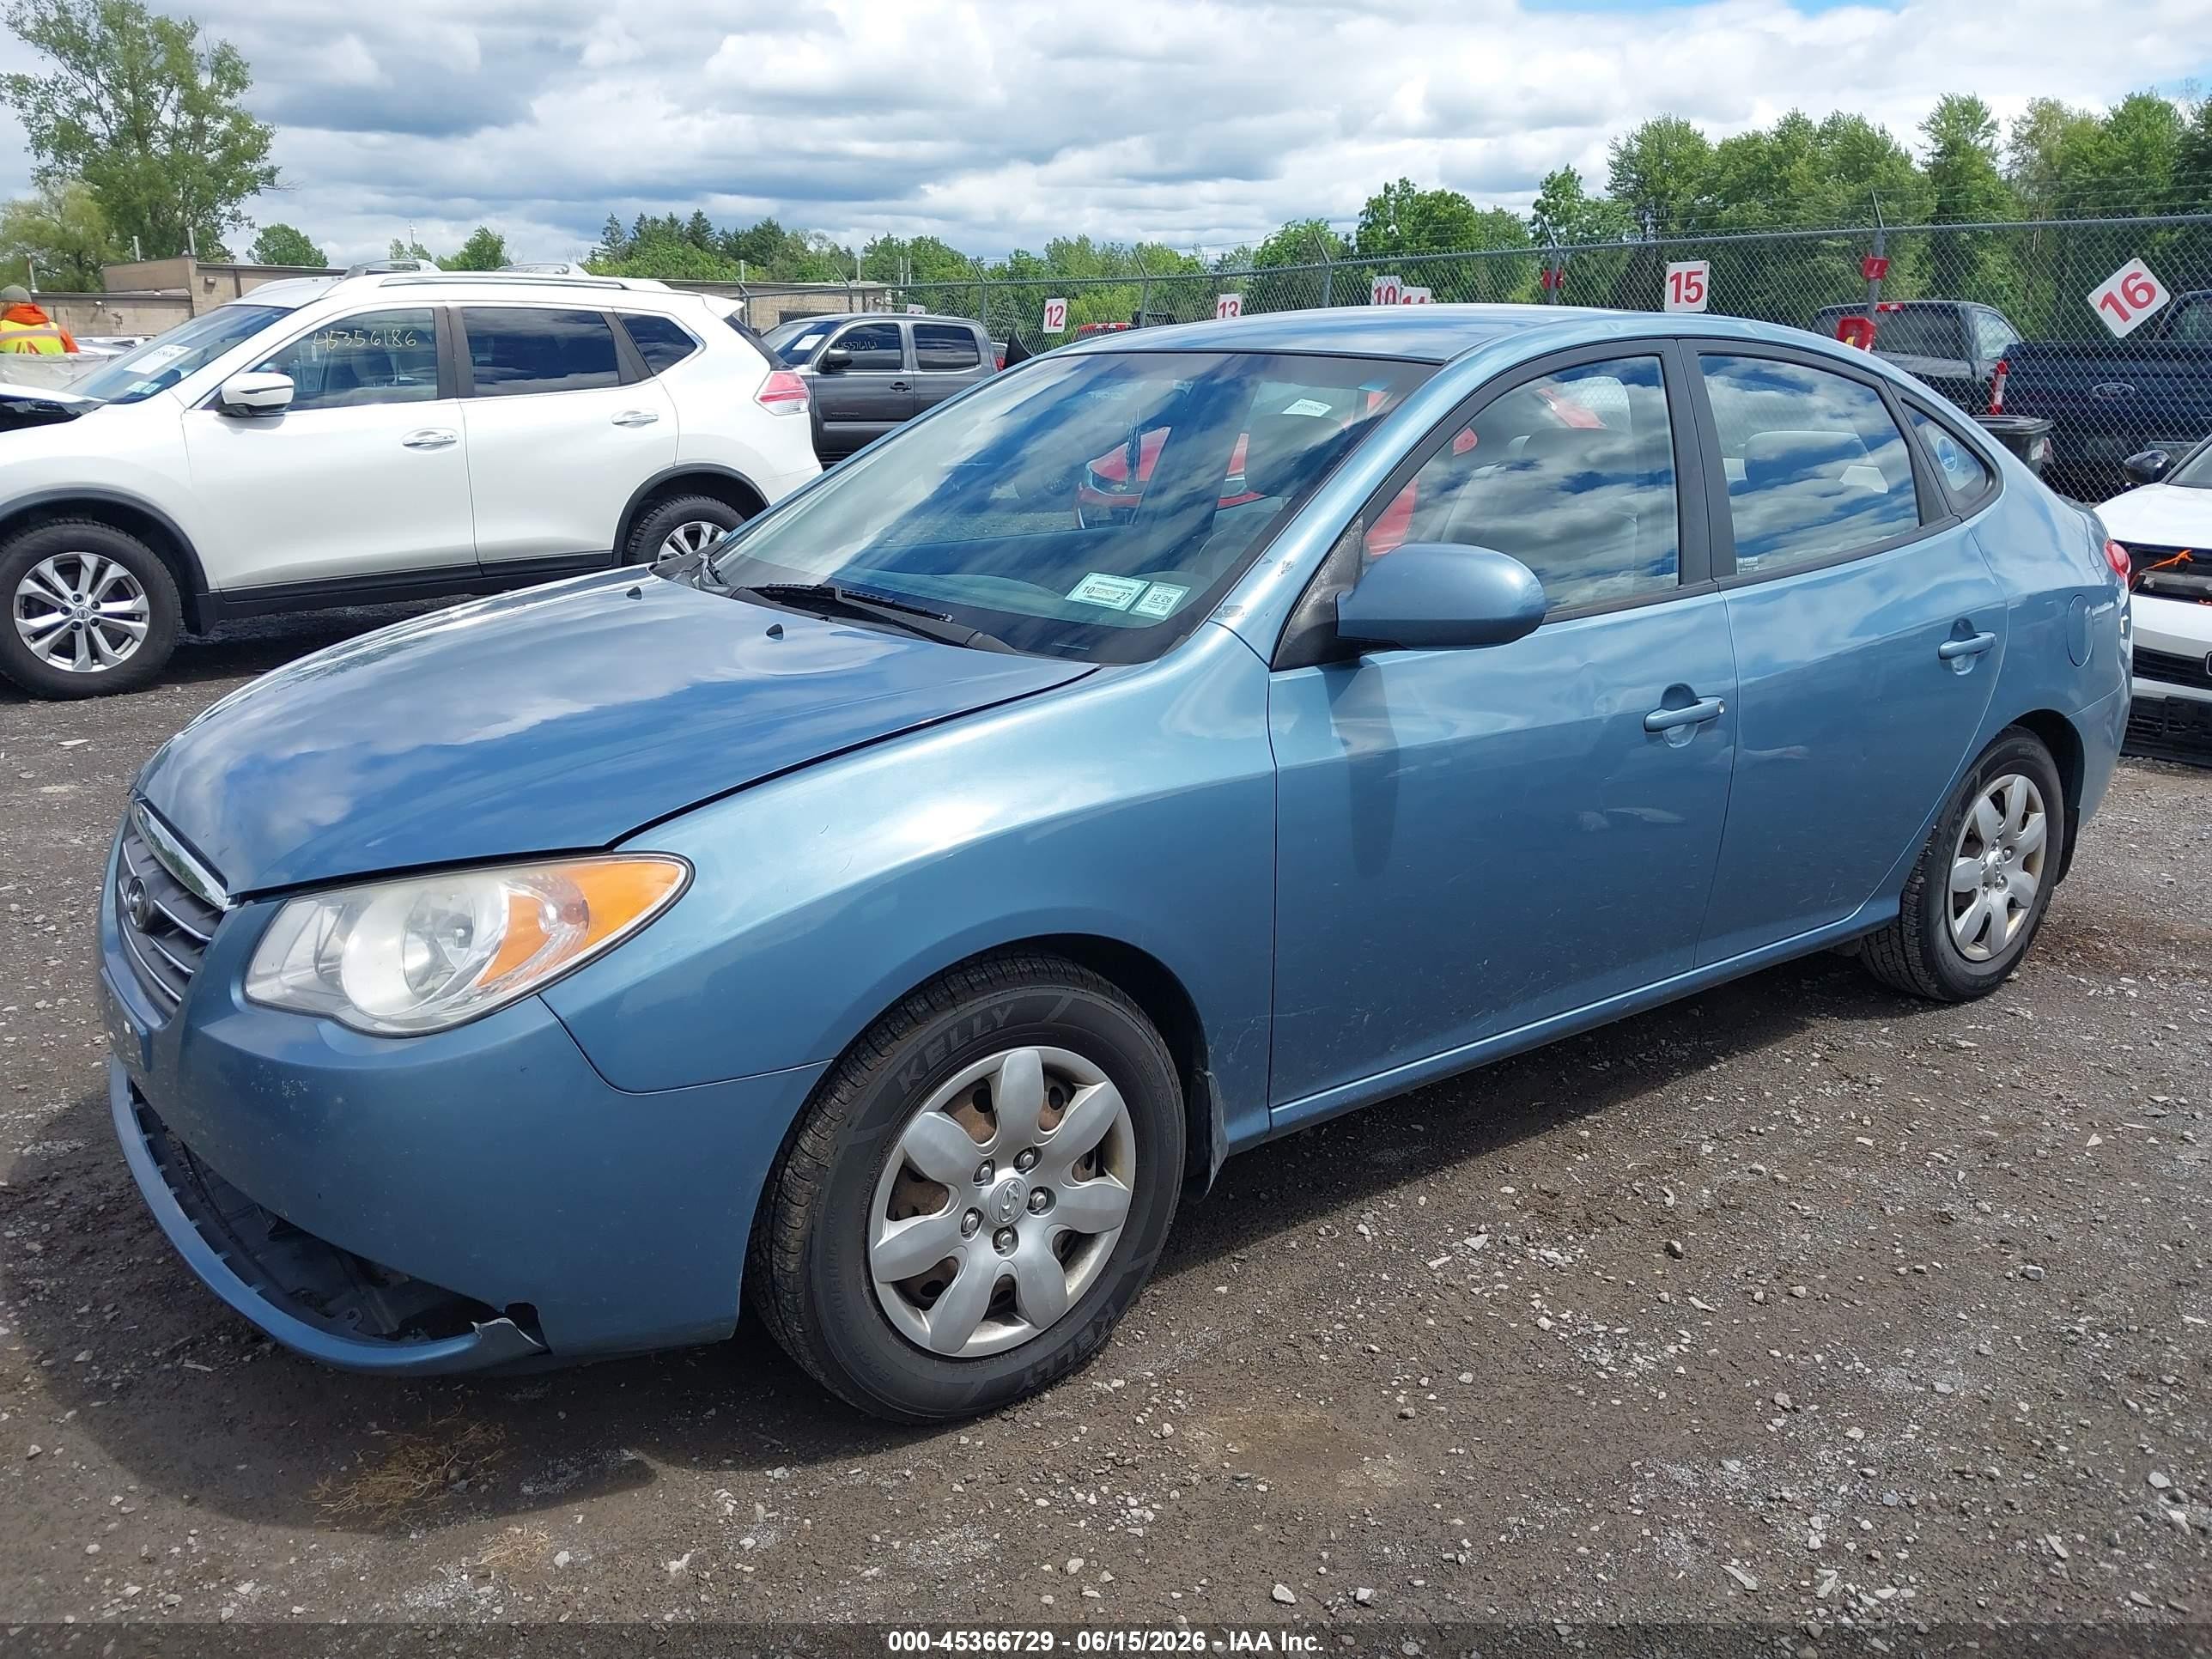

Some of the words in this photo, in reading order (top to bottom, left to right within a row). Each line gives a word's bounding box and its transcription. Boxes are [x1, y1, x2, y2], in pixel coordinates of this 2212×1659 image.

[1374, 285, 1397, 305] 10
[1669, 270, 1704, 304] 15
[2100, 271, 2157, 323] 16
[1046, 305, 1065, 328] 12
[1218, 301, 1239, 318] 13
[313, 329, 417, 353] 45356186
[1082, 586, 1096, 594] 10
[1116, 592, 1133, 601] 27
[896, 1002, 1015, 1096] KELLY
